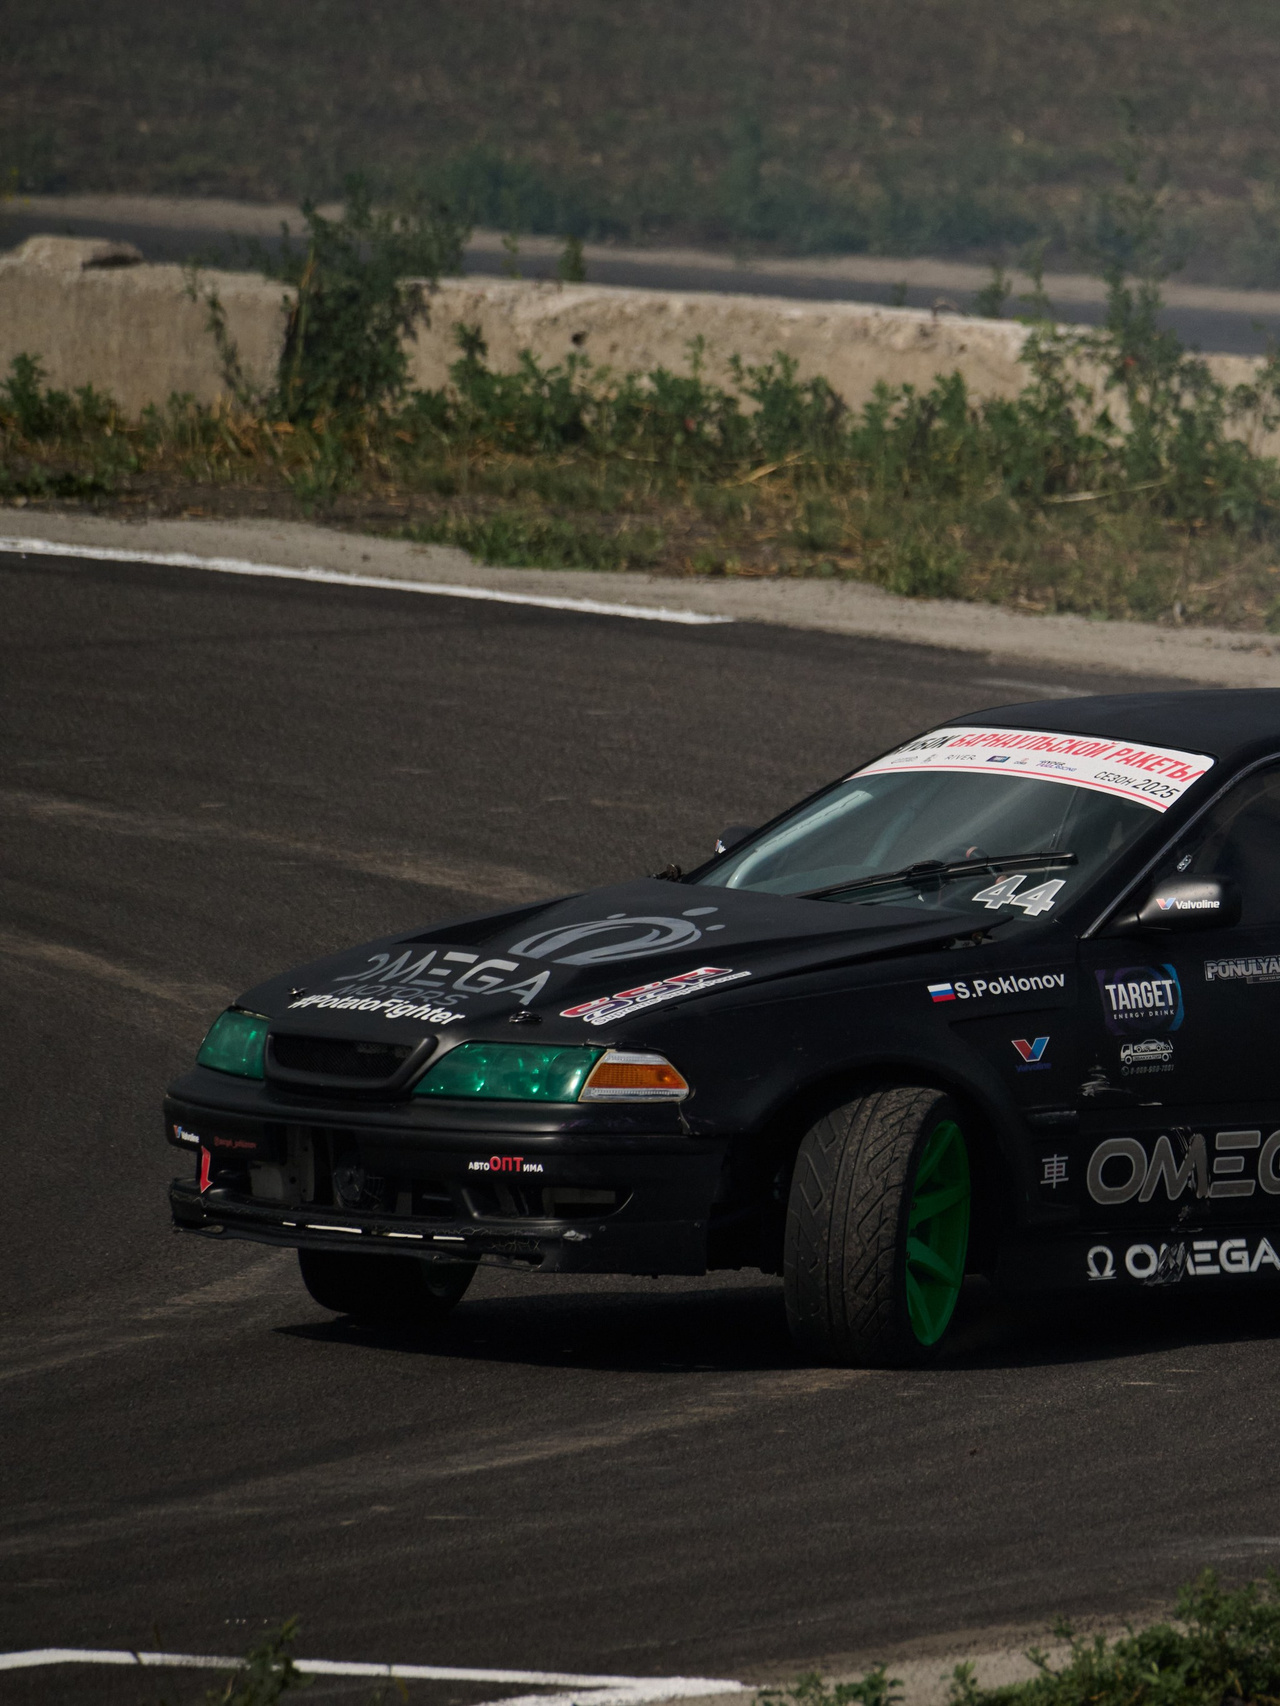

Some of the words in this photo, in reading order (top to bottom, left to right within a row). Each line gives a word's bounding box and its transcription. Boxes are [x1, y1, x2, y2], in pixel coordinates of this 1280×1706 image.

[948, 733, 1117, 758] БАРНАУЛЬСКОЙ
[1103, 747, 1207, 782] РАКЕТЫ
[1094, 771, 1136, 786] СЕЗОН
[1132, 779, 1180, 799] 2025
[971, 875, 1066, 917] 44
[1175, 899, 1220, 910] Valvoline
[331, 984, 470, 1006] MOTORS
[954, 973, 1065, 999] S.Poklonov
[1104, 980, 1174, 1011] TARGET
[288, 994, 466, 1026] #PotatoFighter
[1113, 1011, 1145, 1020] ENERGY
[1148, 1009, 1175, 1018] DRINK
[1040, 1153, 1070, 1190] 車
